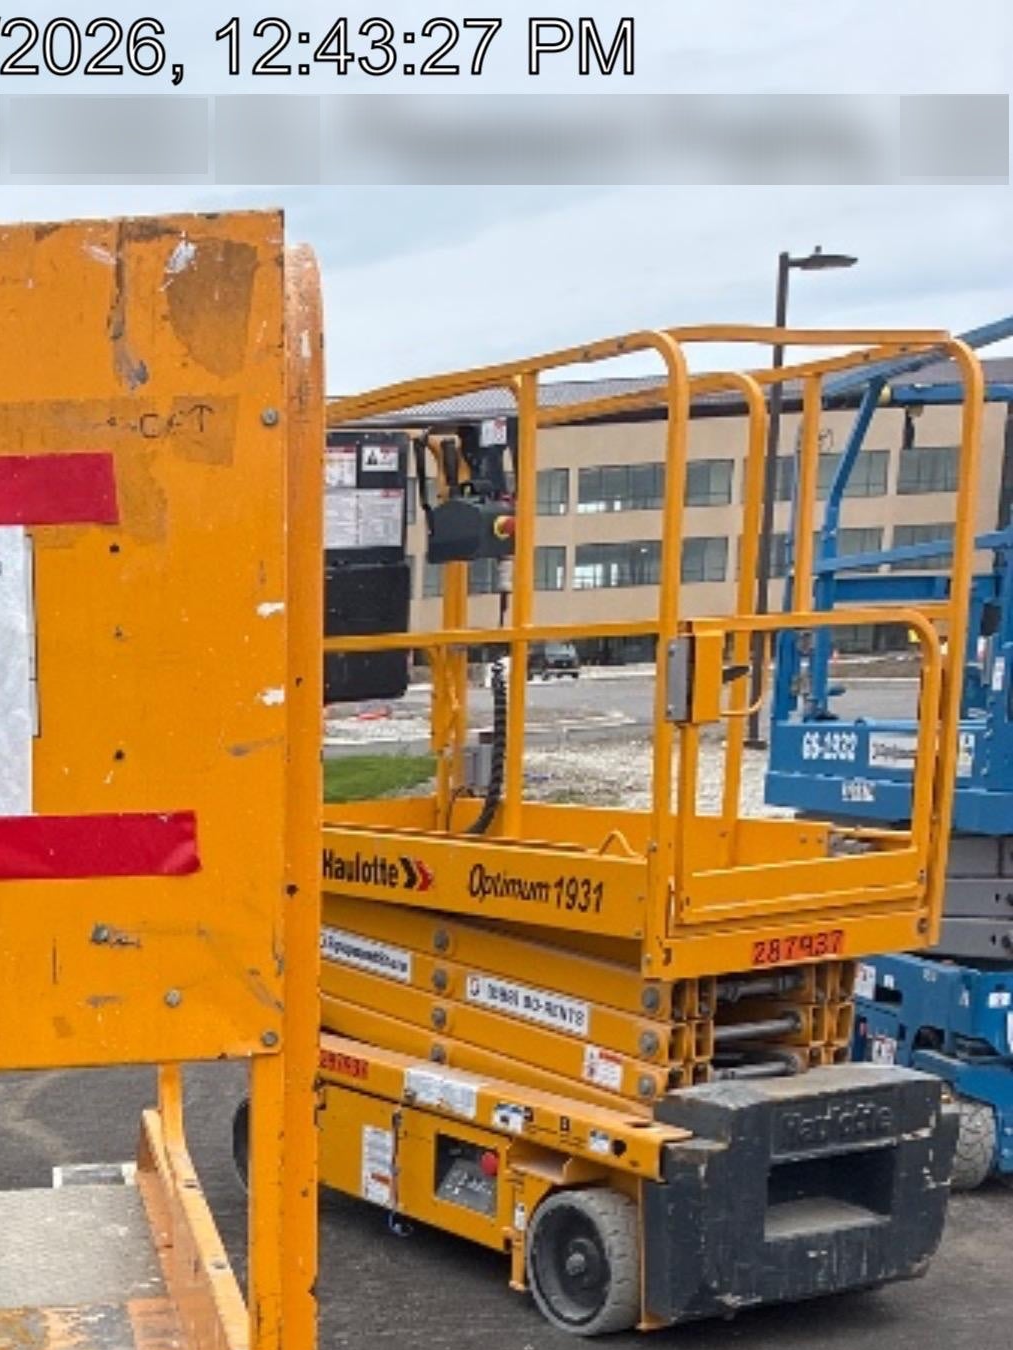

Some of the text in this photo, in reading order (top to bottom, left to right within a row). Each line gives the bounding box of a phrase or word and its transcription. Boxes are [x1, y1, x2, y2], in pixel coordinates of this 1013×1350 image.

[323, 848, 398, 888] Haulotte
[470, 863, 604, 912] Optimum 1931
[752, 929, 844, 964] 287937
